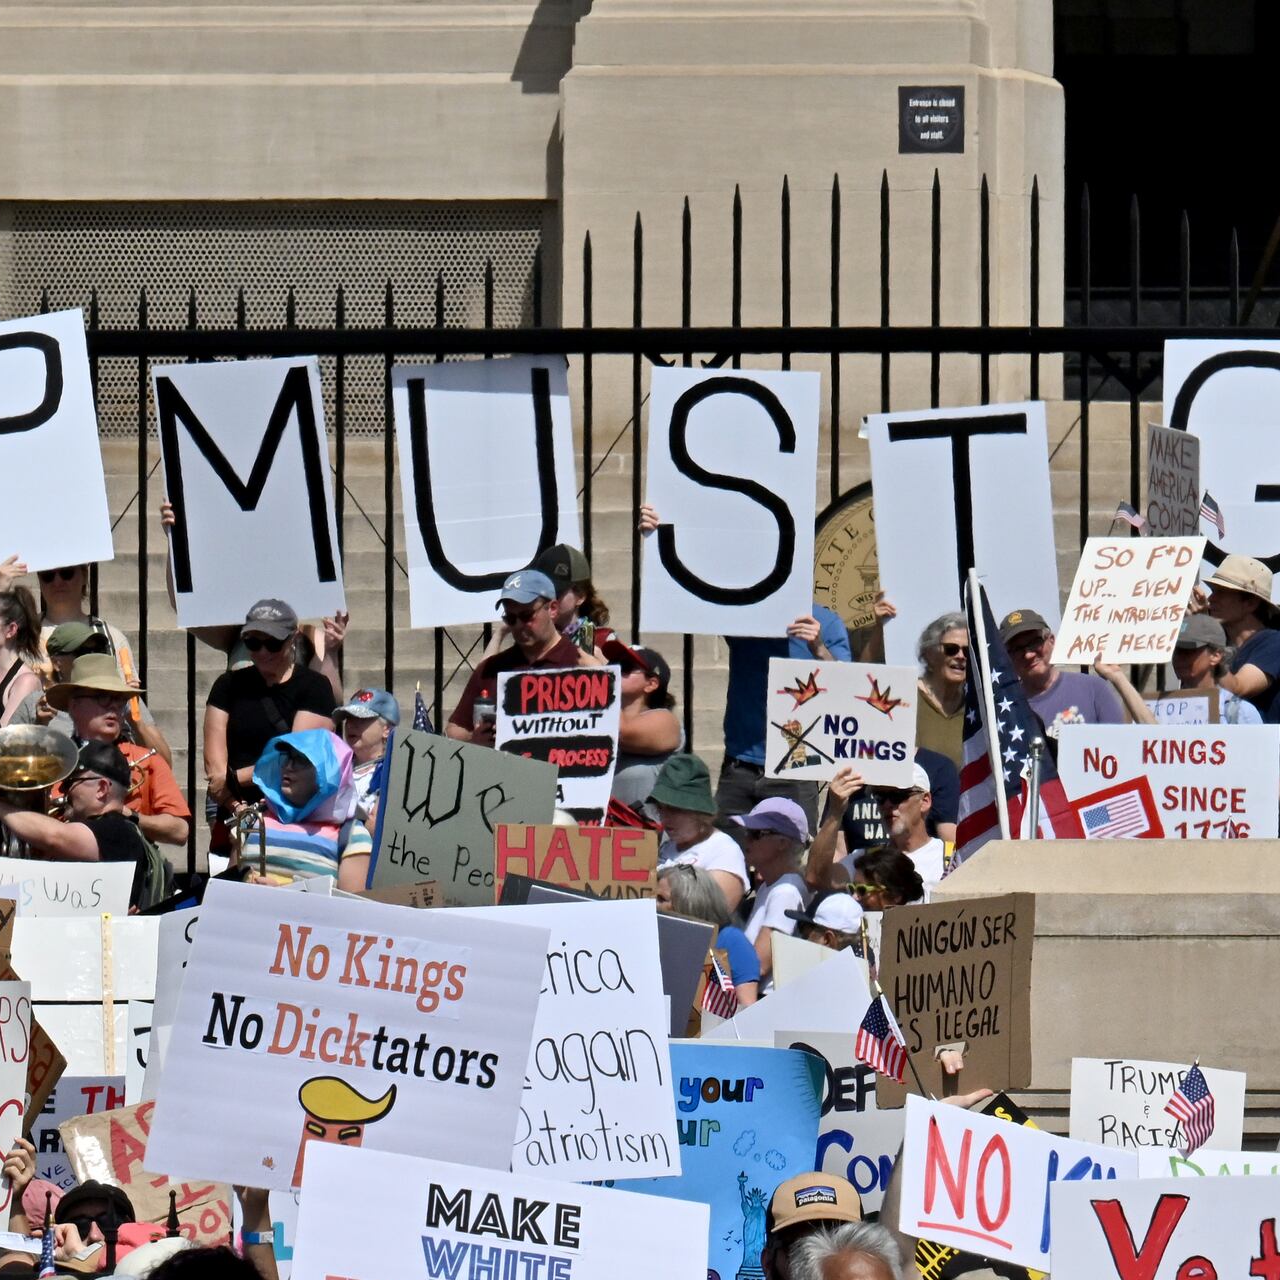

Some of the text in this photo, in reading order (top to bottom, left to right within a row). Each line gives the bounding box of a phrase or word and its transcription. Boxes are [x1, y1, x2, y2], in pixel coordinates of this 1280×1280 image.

[156, 366, 1027, 609] MUST
[1094, 546, 1134, 570] SO
[1132, 576, 1182, 598] EVEN
[1074, 603, 1185, 625] THE INTROVERTS
[1067, 627, 1178, 659] ARE HERE!
[521, 673, 609, 714] PRISON
[512, 713, 603, 734] WITHOUT
[823, 714, 859, 738] NO
[549, 749, 609, 767] PROCESS
[834, 737, 907, 763] KINGS
[1082, 739, 1227, 779] NO KINGS
[1162, 787, 1247, 814] SINCE
[497, 825, 650, 883] HATE
[978, 912, 1017, 949] SER
[268, 923, 467, 1013] No Kings
[894, 958, 995, 1016] HUMANO
[202, 993, 498, 1088] No Dicktators
[426, 1184, 582, 1250] MAKE
